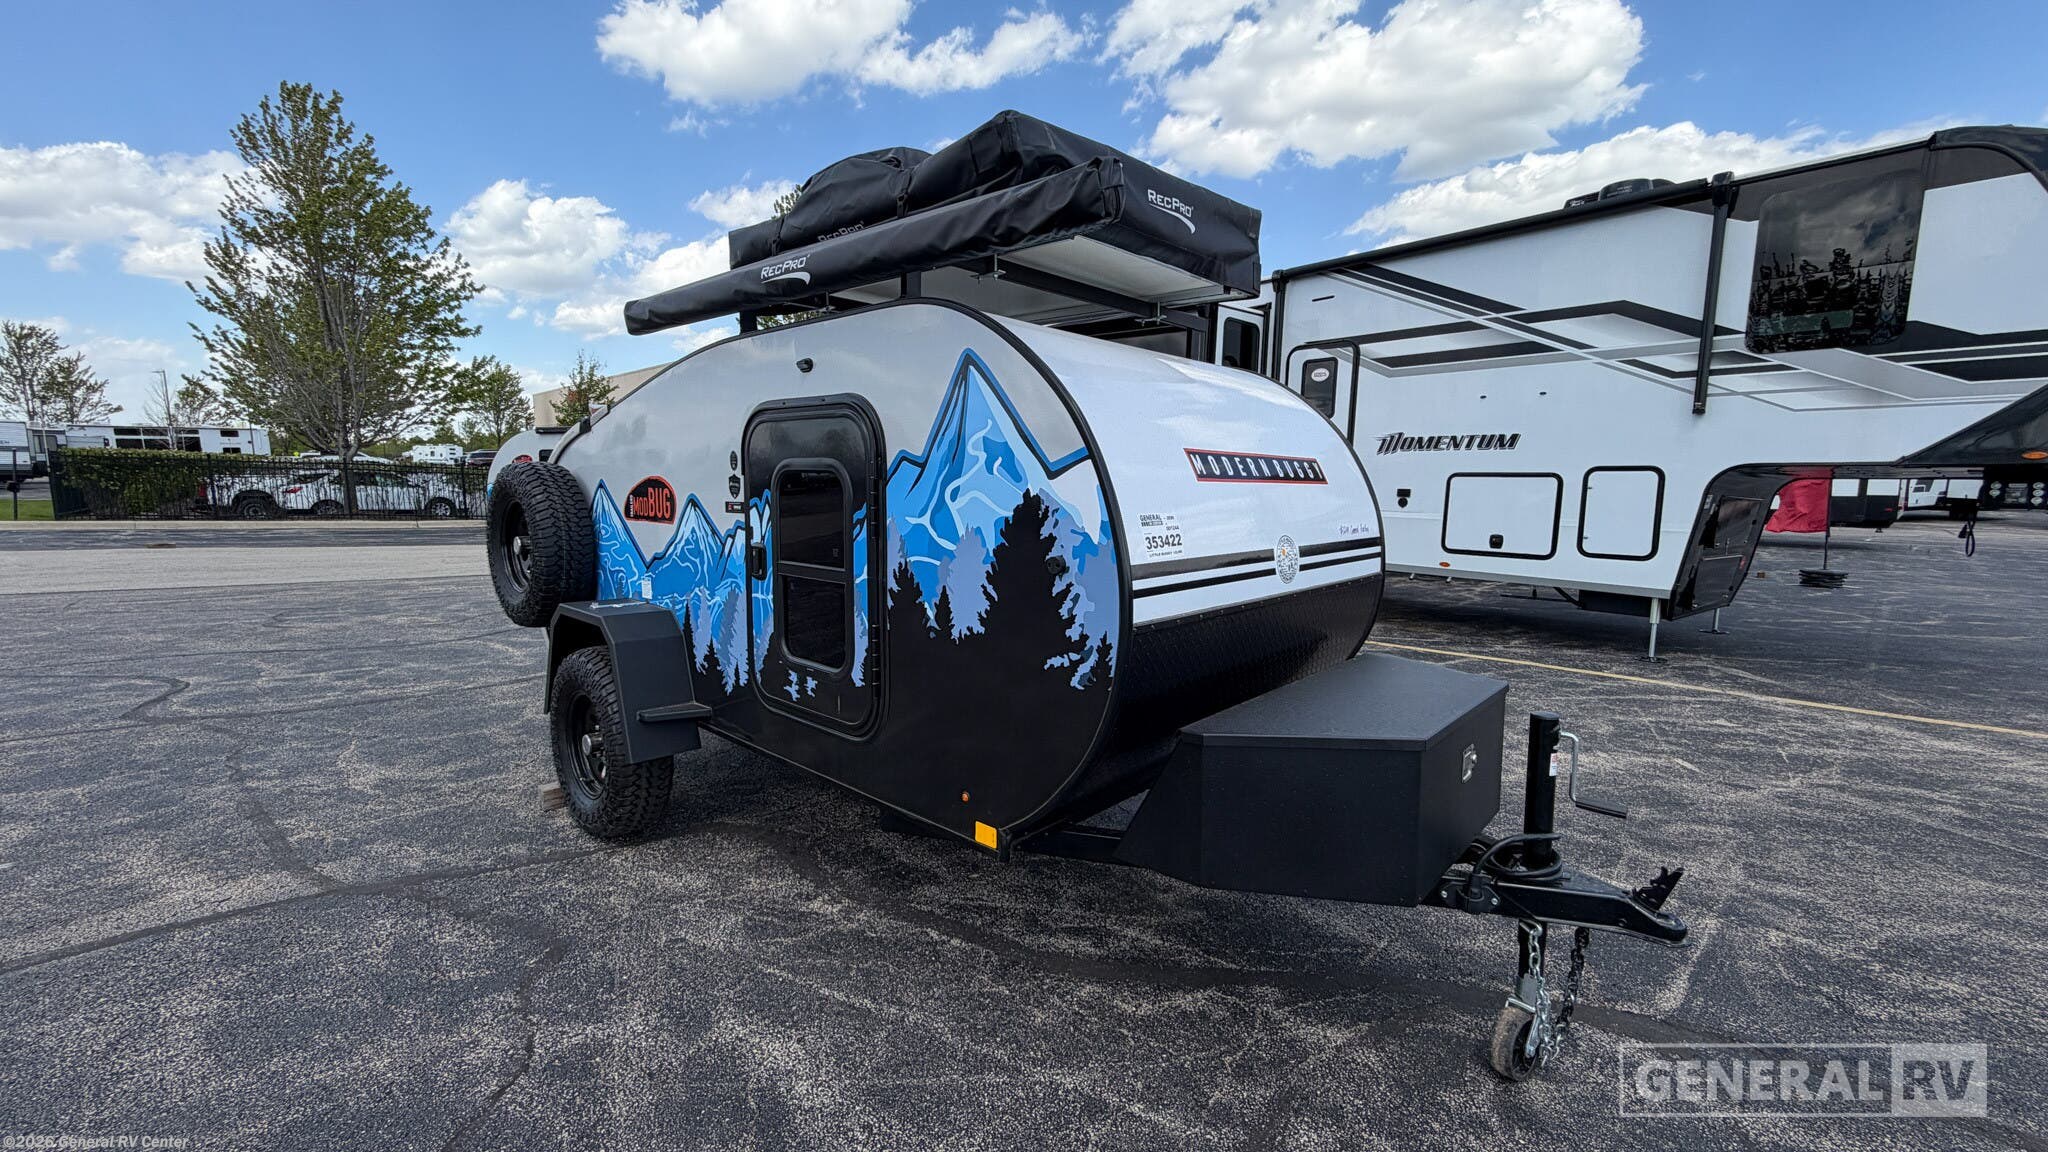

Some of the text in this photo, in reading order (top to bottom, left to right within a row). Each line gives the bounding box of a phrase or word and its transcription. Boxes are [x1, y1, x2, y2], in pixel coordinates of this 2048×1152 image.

[1373, 432, 1521, 455] MOMENTUM
[1190, 454, 1323, 479] MODERN BUGGY
[1145, 533, 1182, 550] 353422
